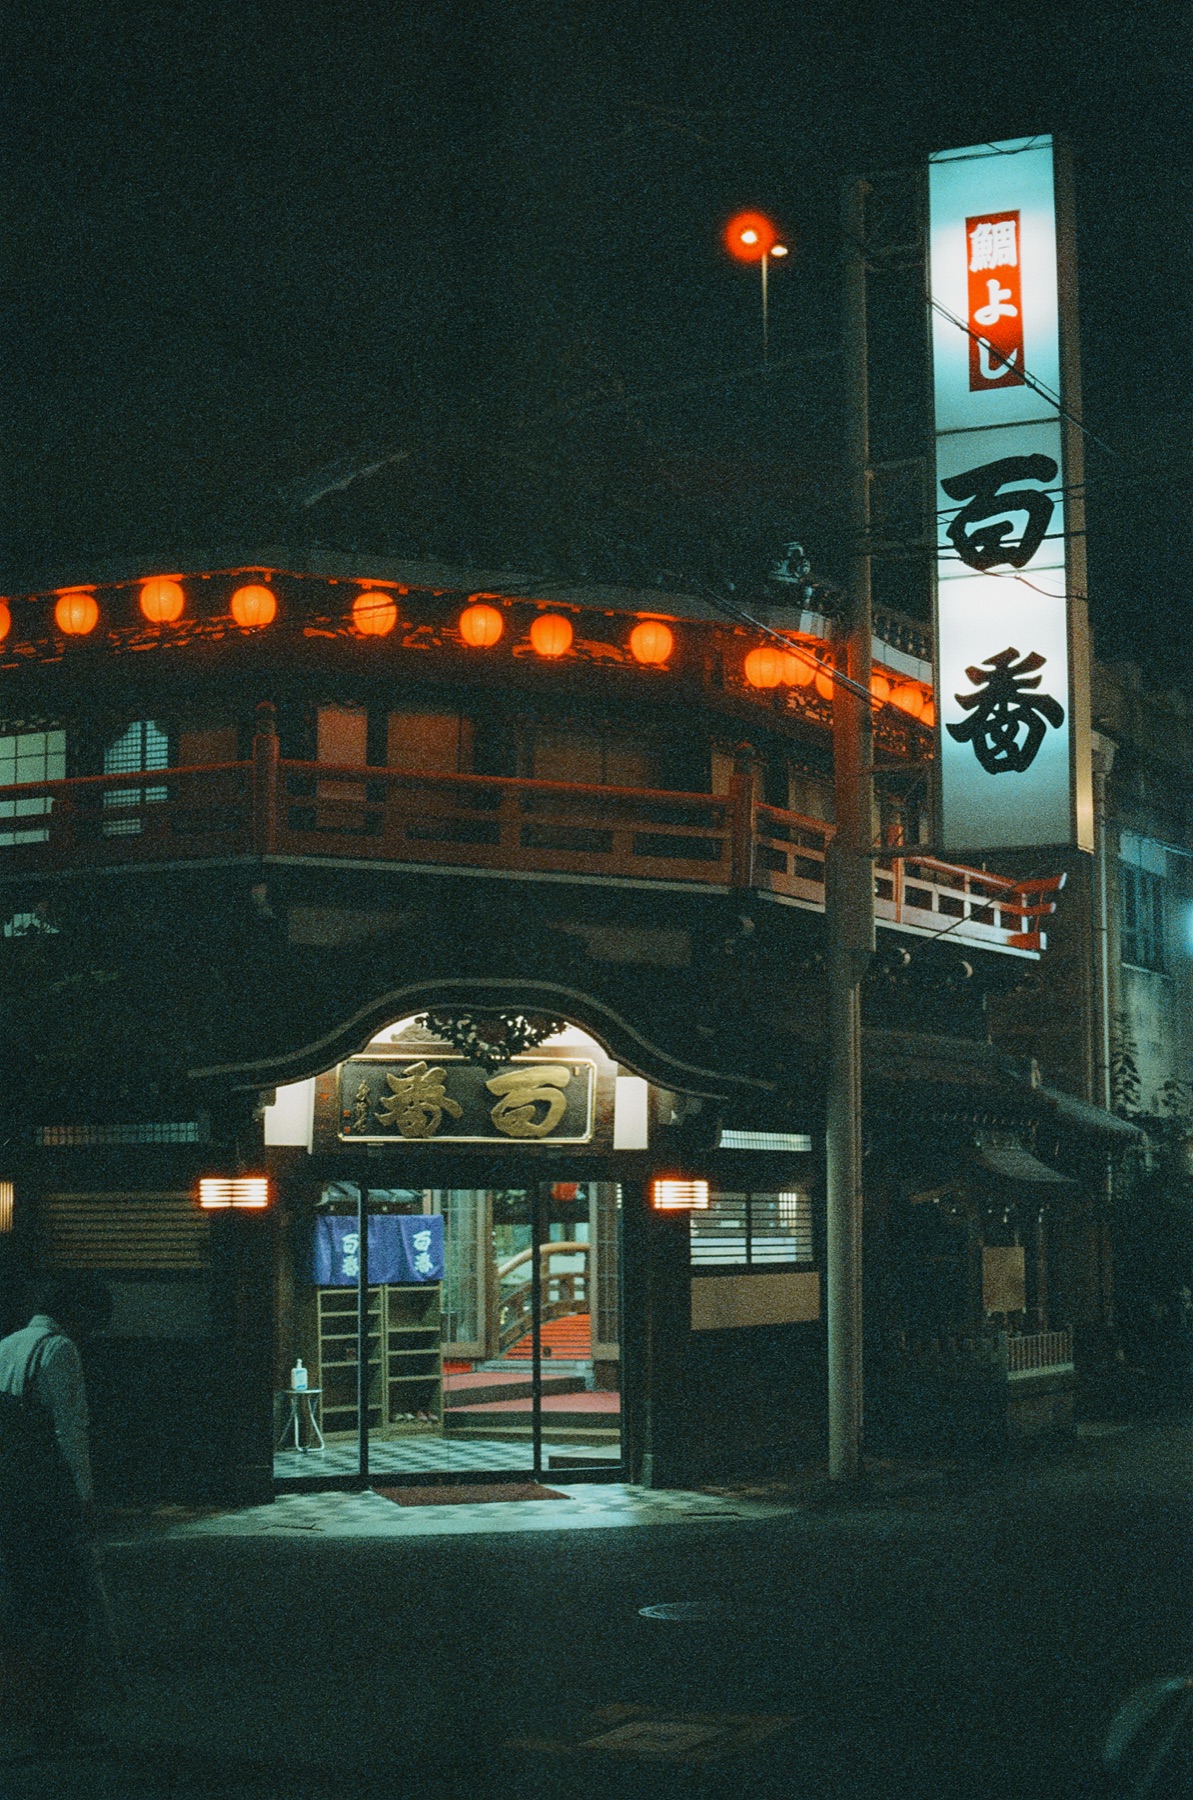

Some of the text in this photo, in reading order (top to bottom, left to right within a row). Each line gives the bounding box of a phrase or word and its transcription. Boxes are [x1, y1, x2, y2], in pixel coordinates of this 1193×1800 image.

[968, 219, 1018, 380] 鯛よし
[940, 452, 1065, 775] 百番
[412, 1229, 433, 1274] 百番
